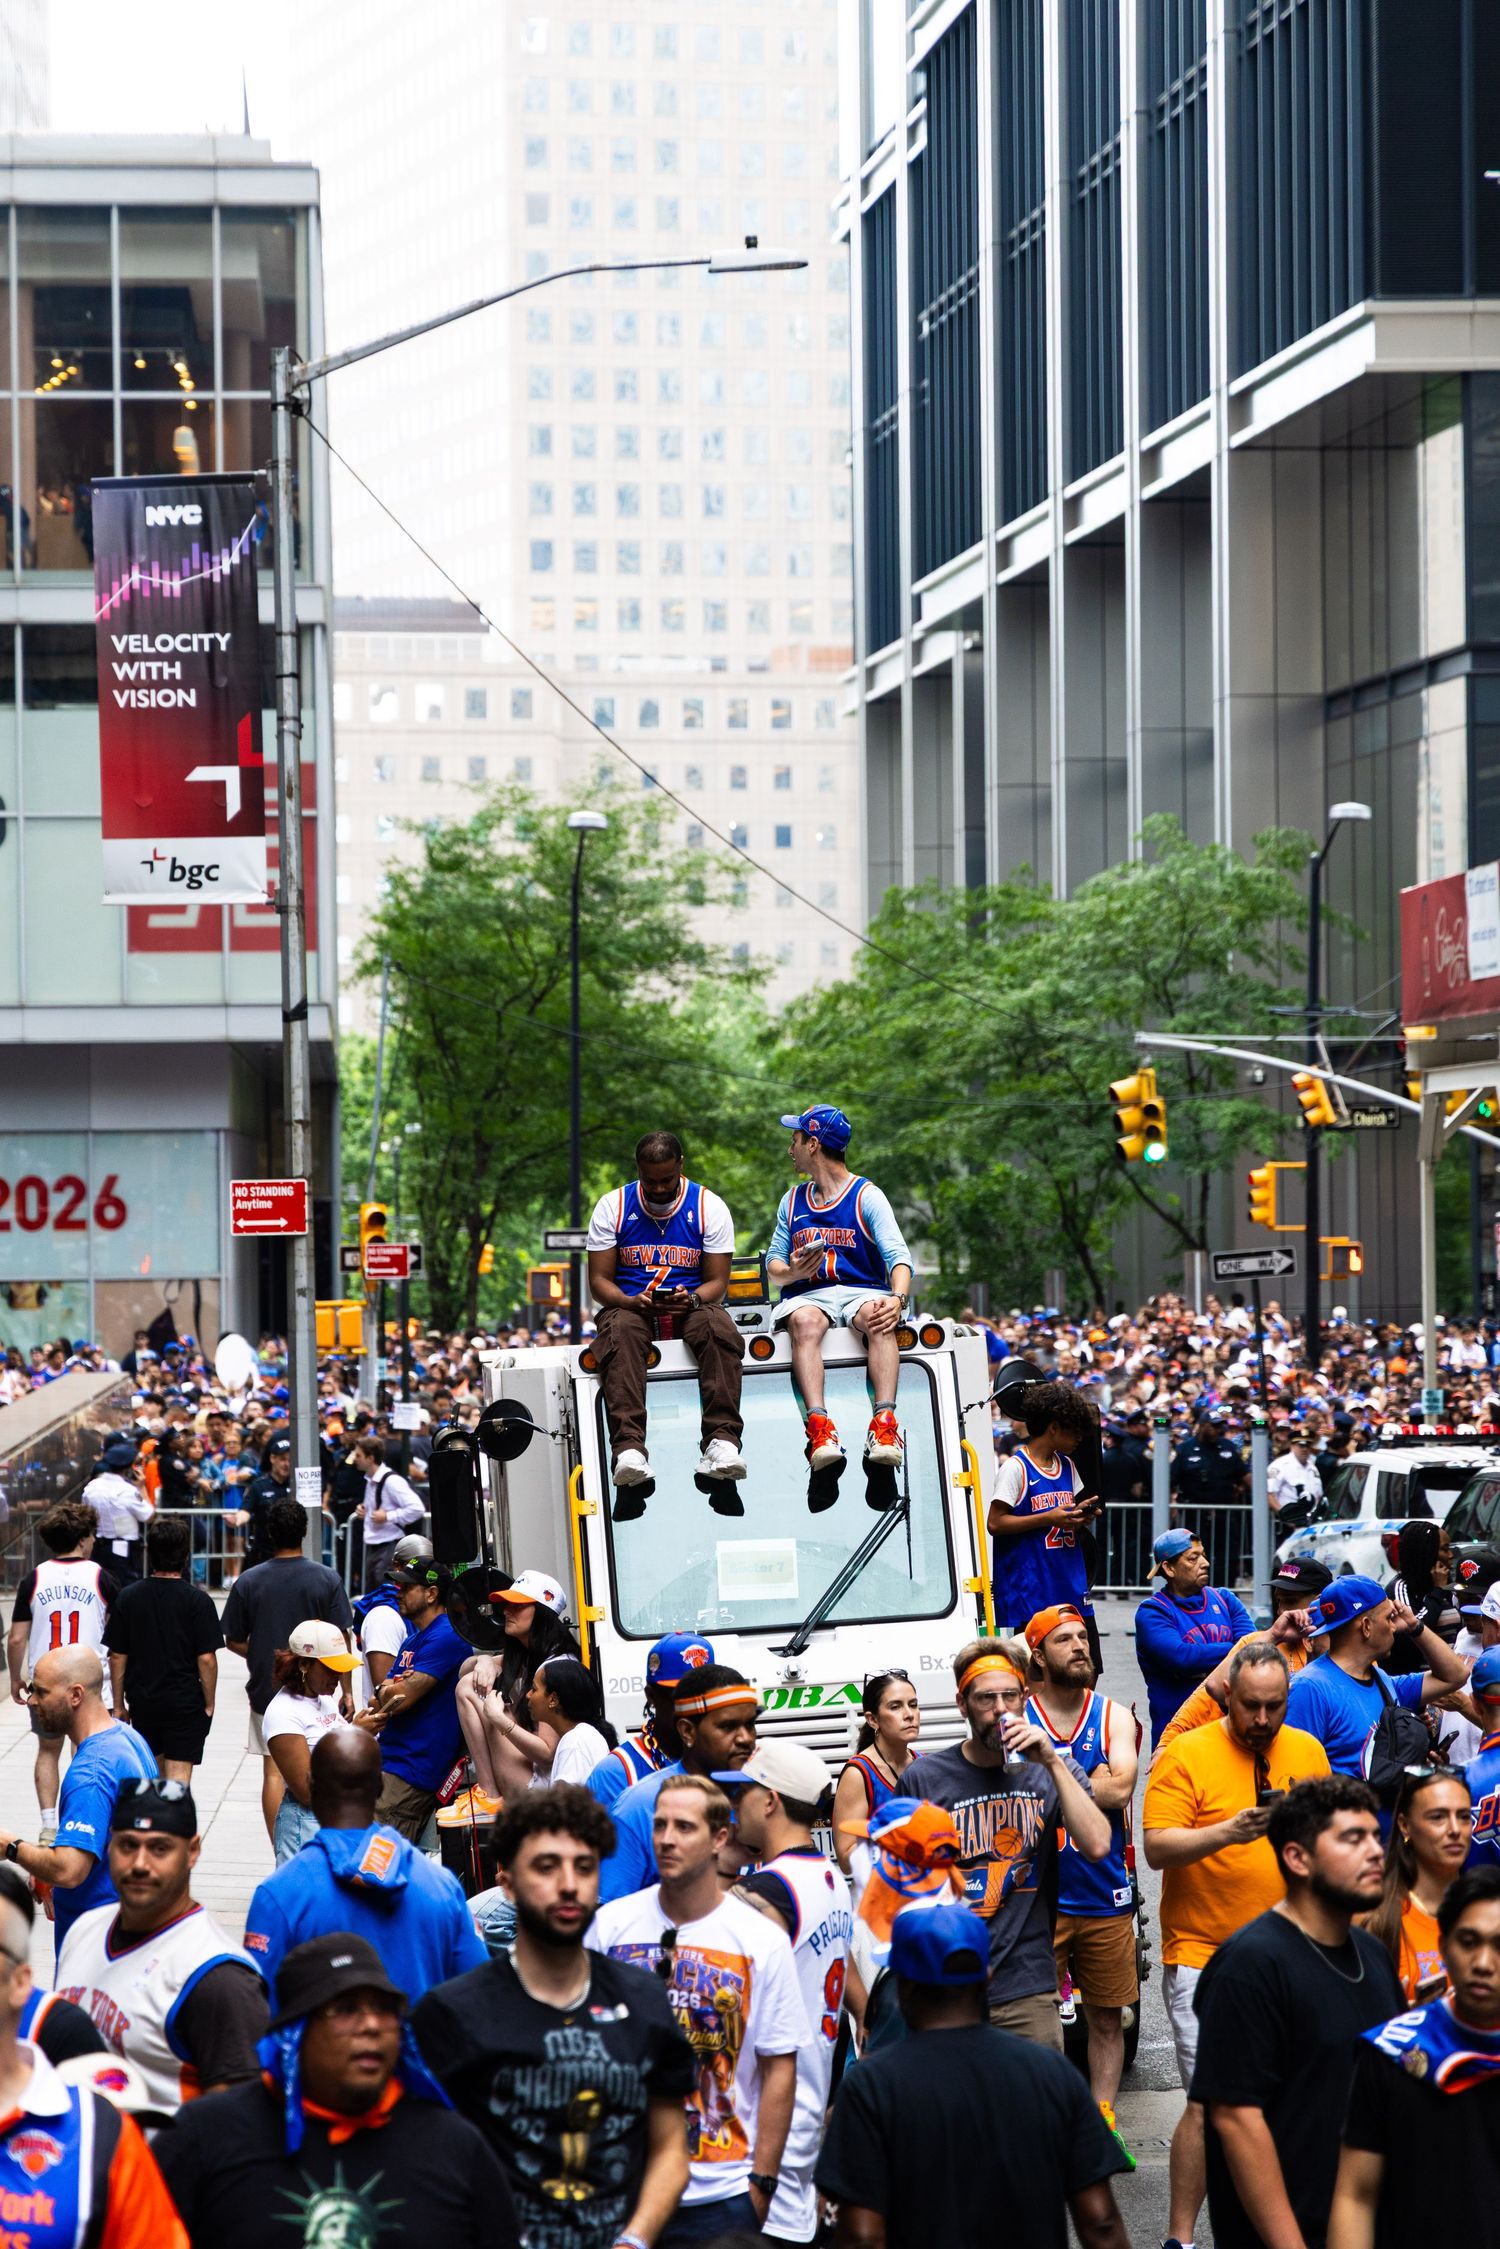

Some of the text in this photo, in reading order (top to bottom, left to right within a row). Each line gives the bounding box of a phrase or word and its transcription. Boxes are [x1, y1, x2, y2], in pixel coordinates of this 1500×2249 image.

[145, 504, 202, 526] NYC
[111, 633, 231, 653] VELOCITY
[112, 661, 182, 680] WITH
[113, 688, 197, 708] VISION
[169, 857, 220, 890] bgc
[235, 1186, 294, 1197] NO STANDING
[235, 1199, 272, 1211] Anytime
[792, 1228, 856, 1250] NEW YORK
[619, 1245, 701, 1267] NEW YORK
[1221, 1257, 1284, 1273] ONE WAY
[645, 1266, 673, 1291] 7
[1031, 1492, 1055, 1512] NEW
[37, 1585, 95, 1606] BRUNSON
[49, 1610, 79, 1651] 11
[954, 1790, 1037, 1810] 2025-26 NBA FINALS
[949, 1797, 1045, 1859] HAMPIONS
[647, 1947, 705, 1962] NE YORK
[667, 1992, 701, 2009] 026
